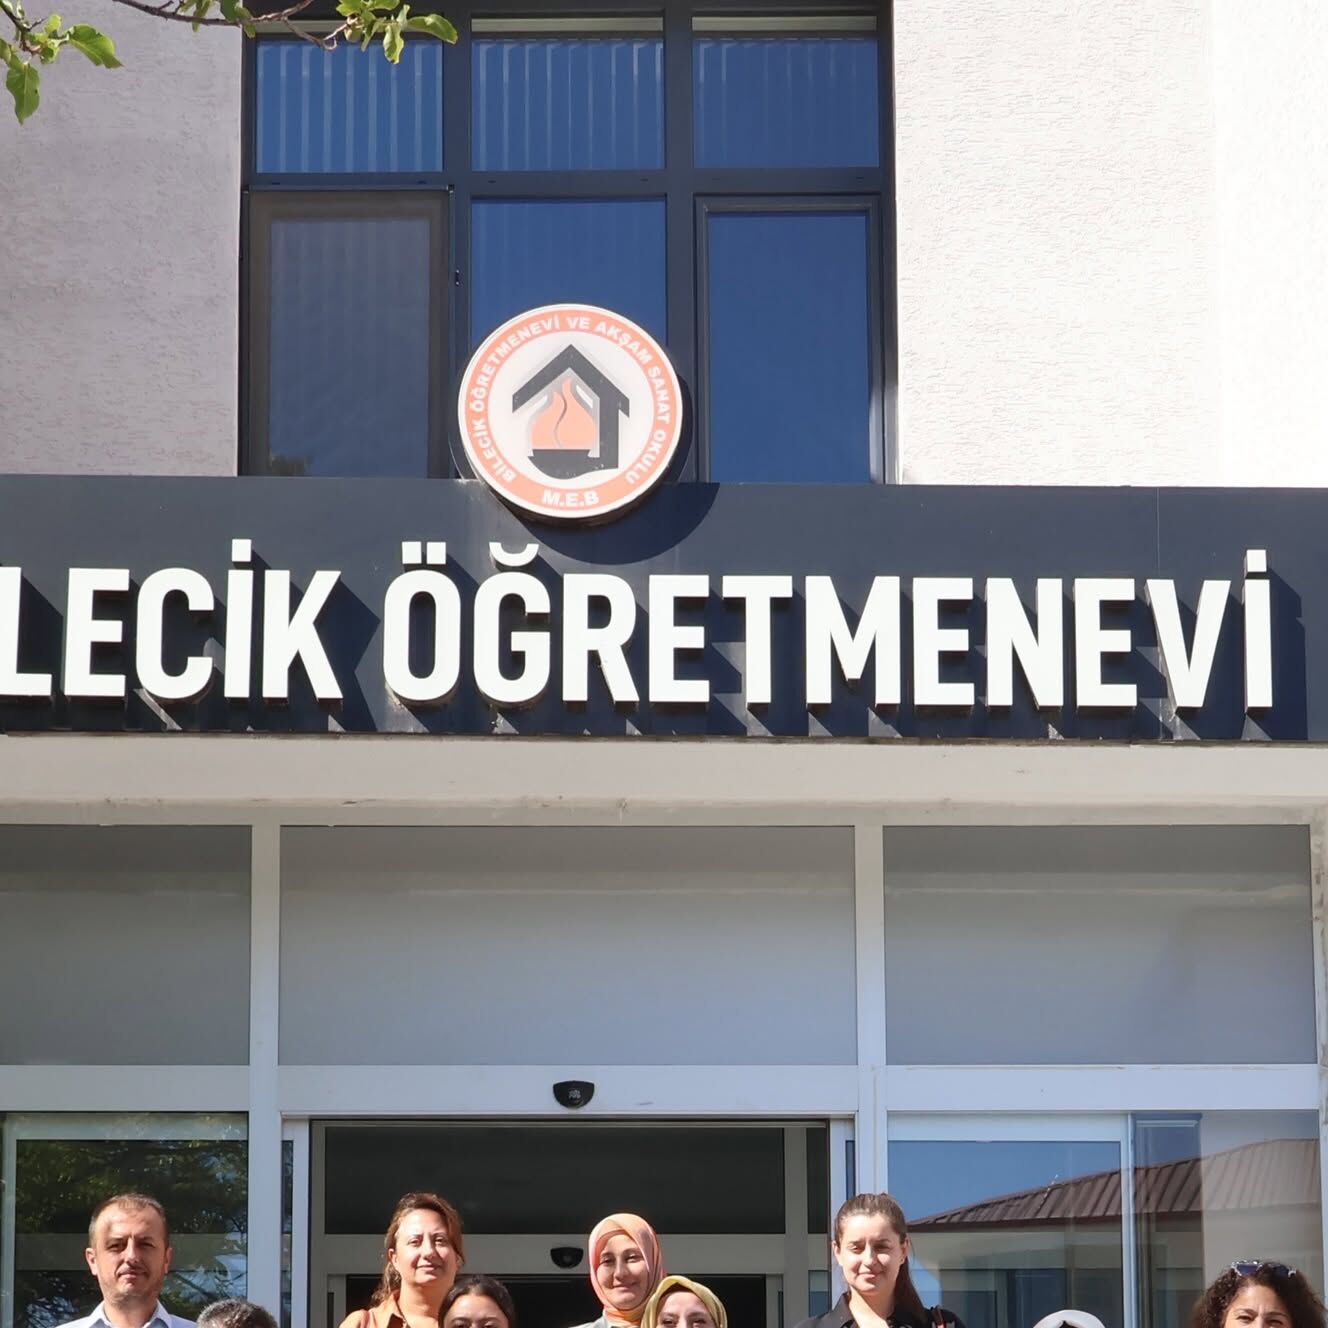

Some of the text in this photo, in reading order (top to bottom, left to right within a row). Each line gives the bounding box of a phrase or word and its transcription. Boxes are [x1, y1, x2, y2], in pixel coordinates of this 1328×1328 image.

[469, 314, 670, 485] BİLECİK ÖĞRETMENEVİ VE AKŞAM SANAT OKULU
[541, 489, 600, 507] M.E.B
[383, 541, 1273, 708] ÖĞRETMENEVİ
